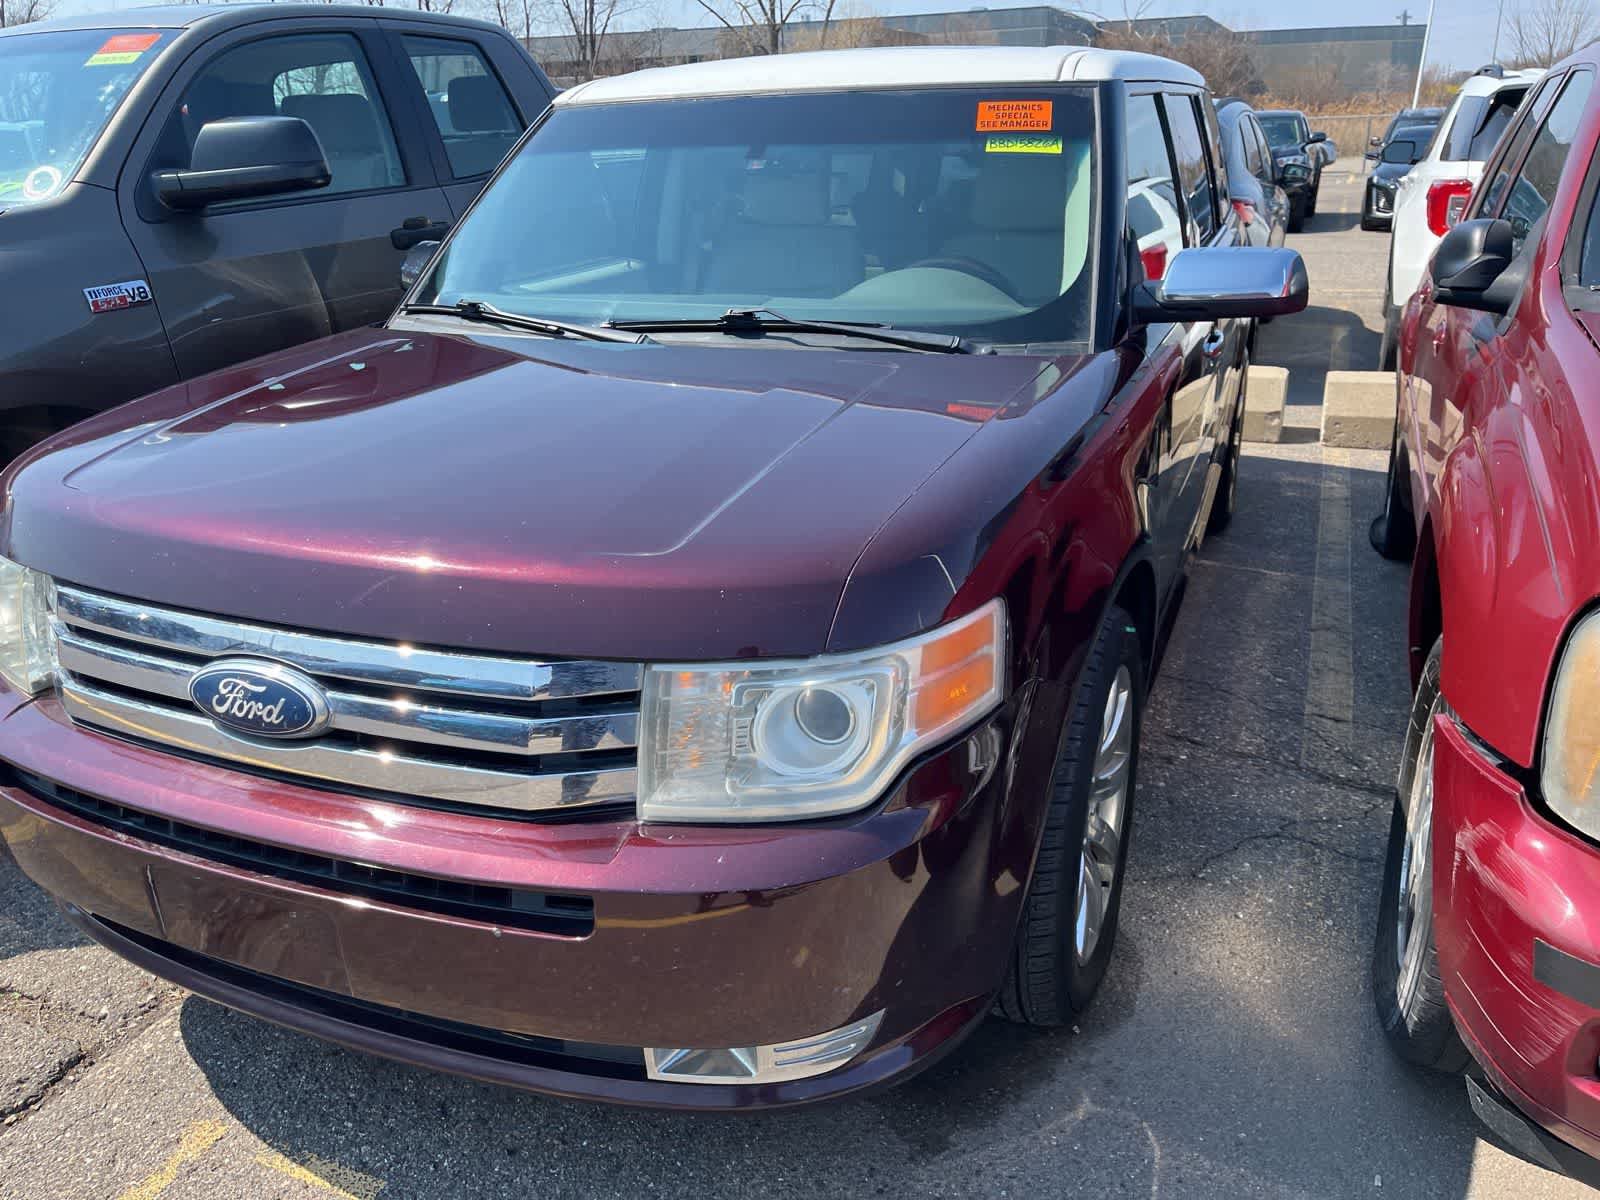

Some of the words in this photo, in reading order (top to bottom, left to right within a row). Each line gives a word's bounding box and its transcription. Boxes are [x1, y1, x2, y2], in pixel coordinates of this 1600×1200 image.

[980, 120, 998, 128] SEE
[1000, 120, 1048, 128] MANAGER
[124, 286, 149, 301] V8
[211, 678, 285, 724] Ford
